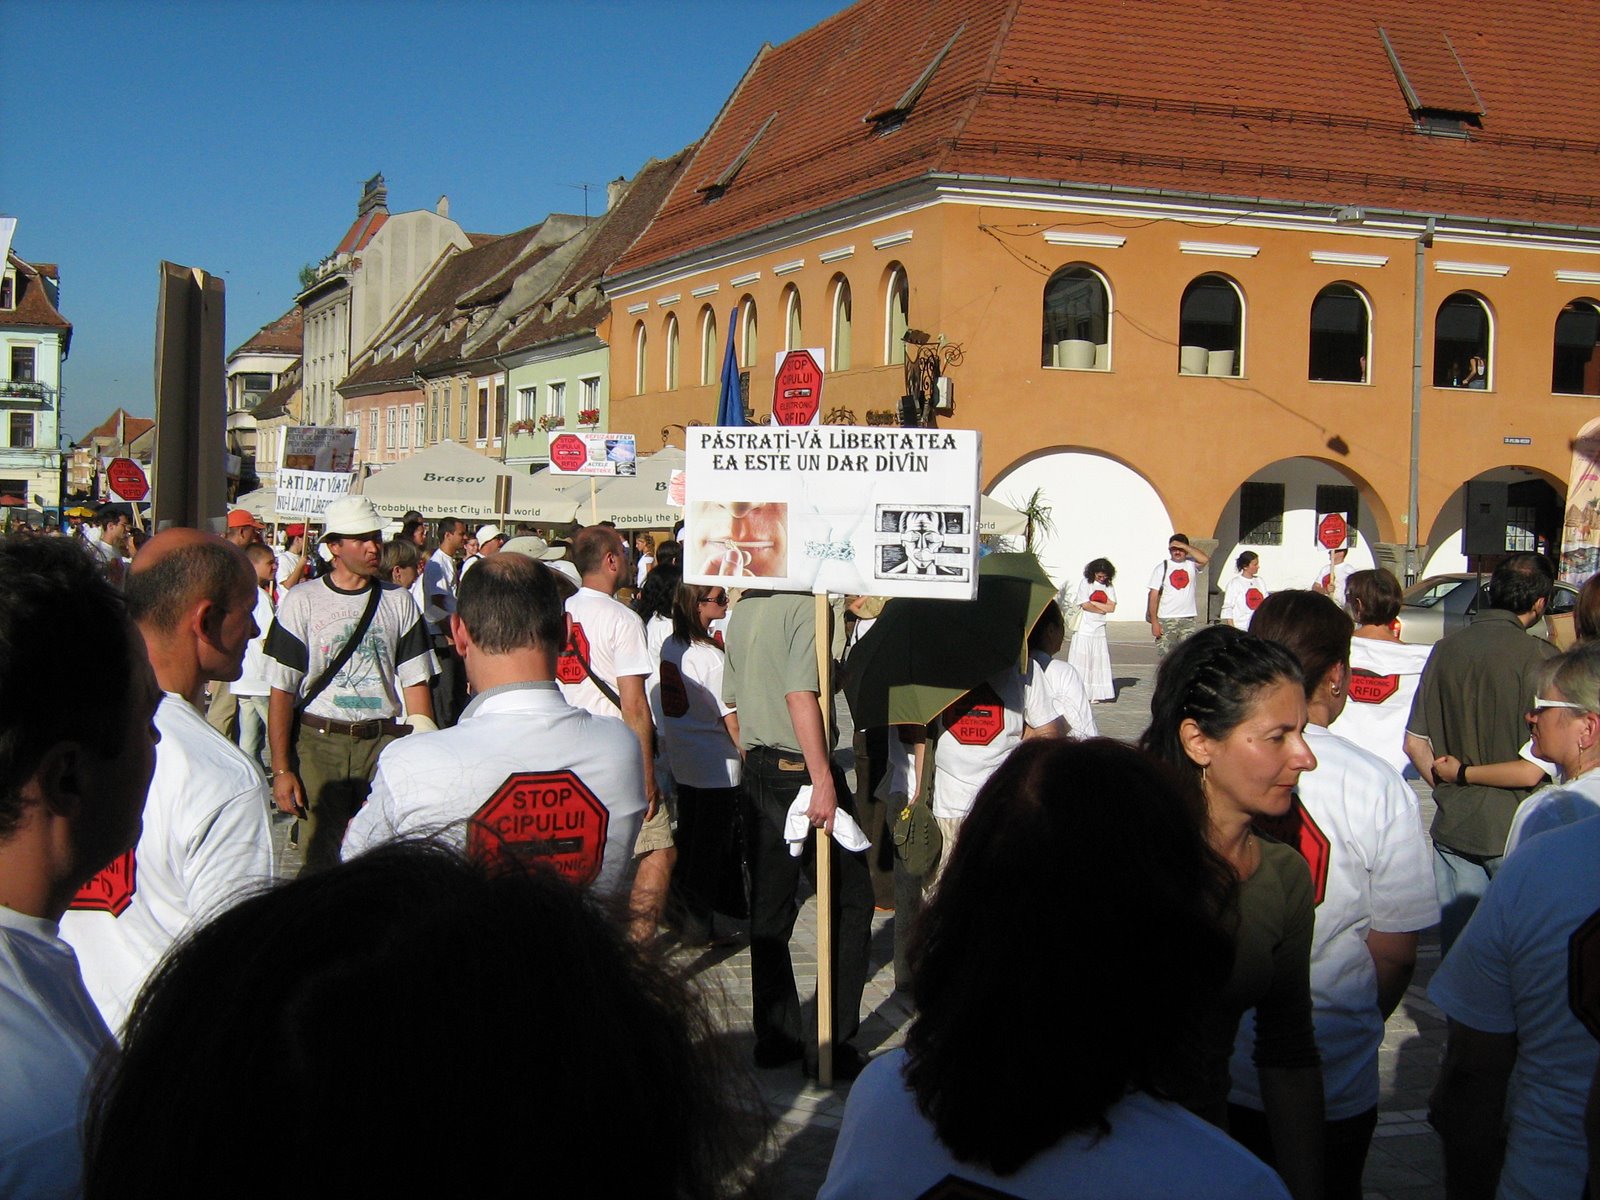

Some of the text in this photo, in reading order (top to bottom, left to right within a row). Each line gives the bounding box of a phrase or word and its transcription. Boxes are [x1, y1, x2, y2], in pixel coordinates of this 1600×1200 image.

[788, 359, 808, 372] STOP
[785, 412, 806, 425] RFID
[713, 454, 739, 471] EA
[745, 454, 791, 471] ESTE
[797, 454, 820, 471] UN
[827, 454, 868, 472] DAR
[306, 476, 326, 492] DAT
[418, 504, 434, 513] the
[437, 505, 458, 514] best
[460, 505, 480, 515] City
[483, 506, 492, 514] in
[514, 508, 541, 517] world
[611, 514, 652, 524] Probably
[655, 514, 671, 522] the
[1354, 686, 1381, 698] RFID
[960, 727, 987, 738] RFID
[512, 788, 573, 810] STOP
[497, 811, 586, 835] CIPULUI
